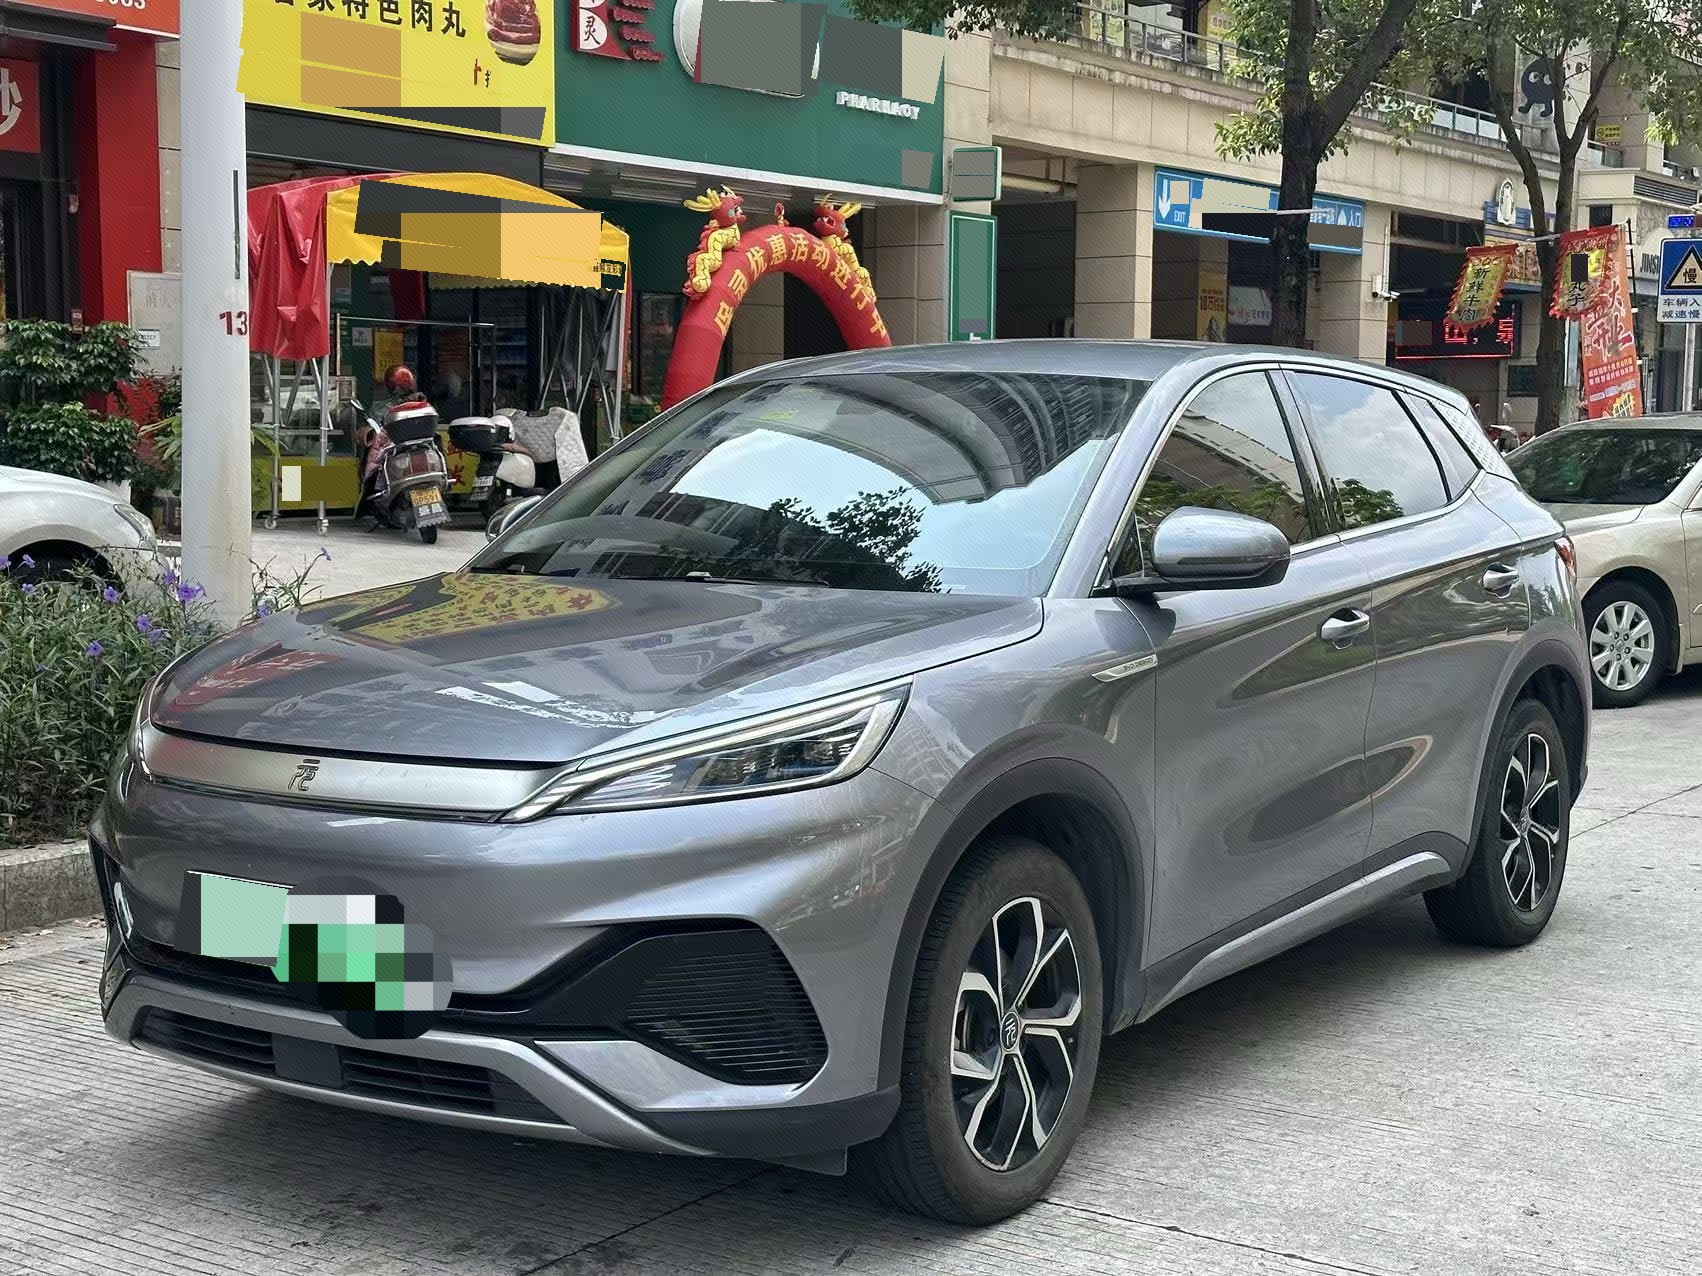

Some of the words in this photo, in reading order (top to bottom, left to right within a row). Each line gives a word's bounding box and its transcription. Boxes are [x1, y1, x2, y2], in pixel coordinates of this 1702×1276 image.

[836, 91, 920, 120] PHARMACY
[1174, 210, 1185, 223] EXIT
[1683, 268, 1698, 284] 慢
[219, 310, 248, 336] 13
